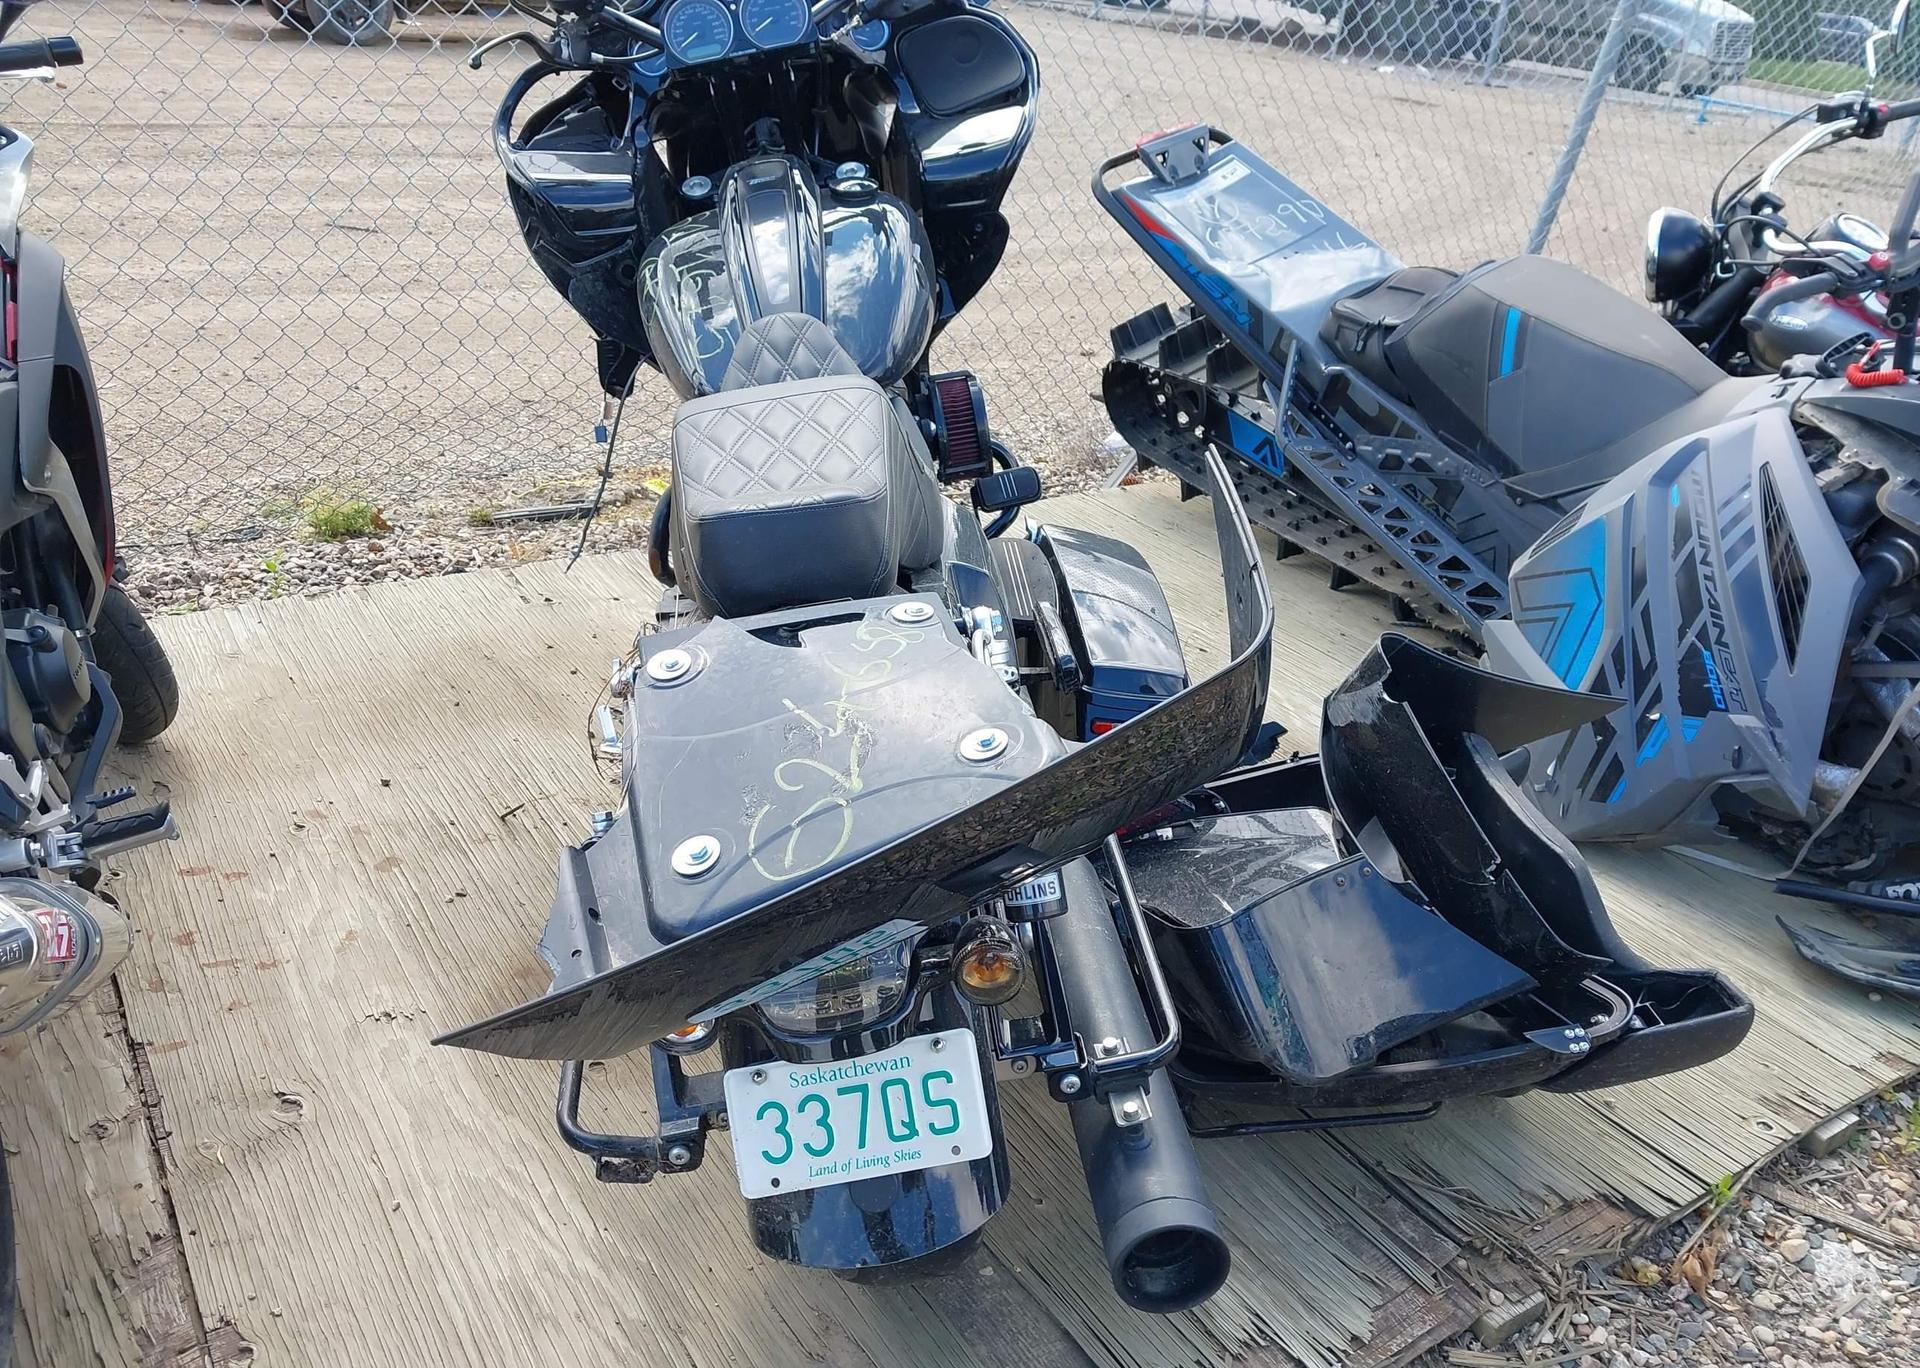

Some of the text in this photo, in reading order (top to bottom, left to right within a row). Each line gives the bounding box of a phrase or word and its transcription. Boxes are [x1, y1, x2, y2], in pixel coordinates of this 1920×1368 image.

[1702, 650, 1726, 710] 8000
[1886, 882, 1920, 900] FO
[789, 1055, 911, 1088] Saskatchewan
[756, 1069, 960, 1165] 337QS
[808, 1149, 922, 1178] Land of Living Skies
